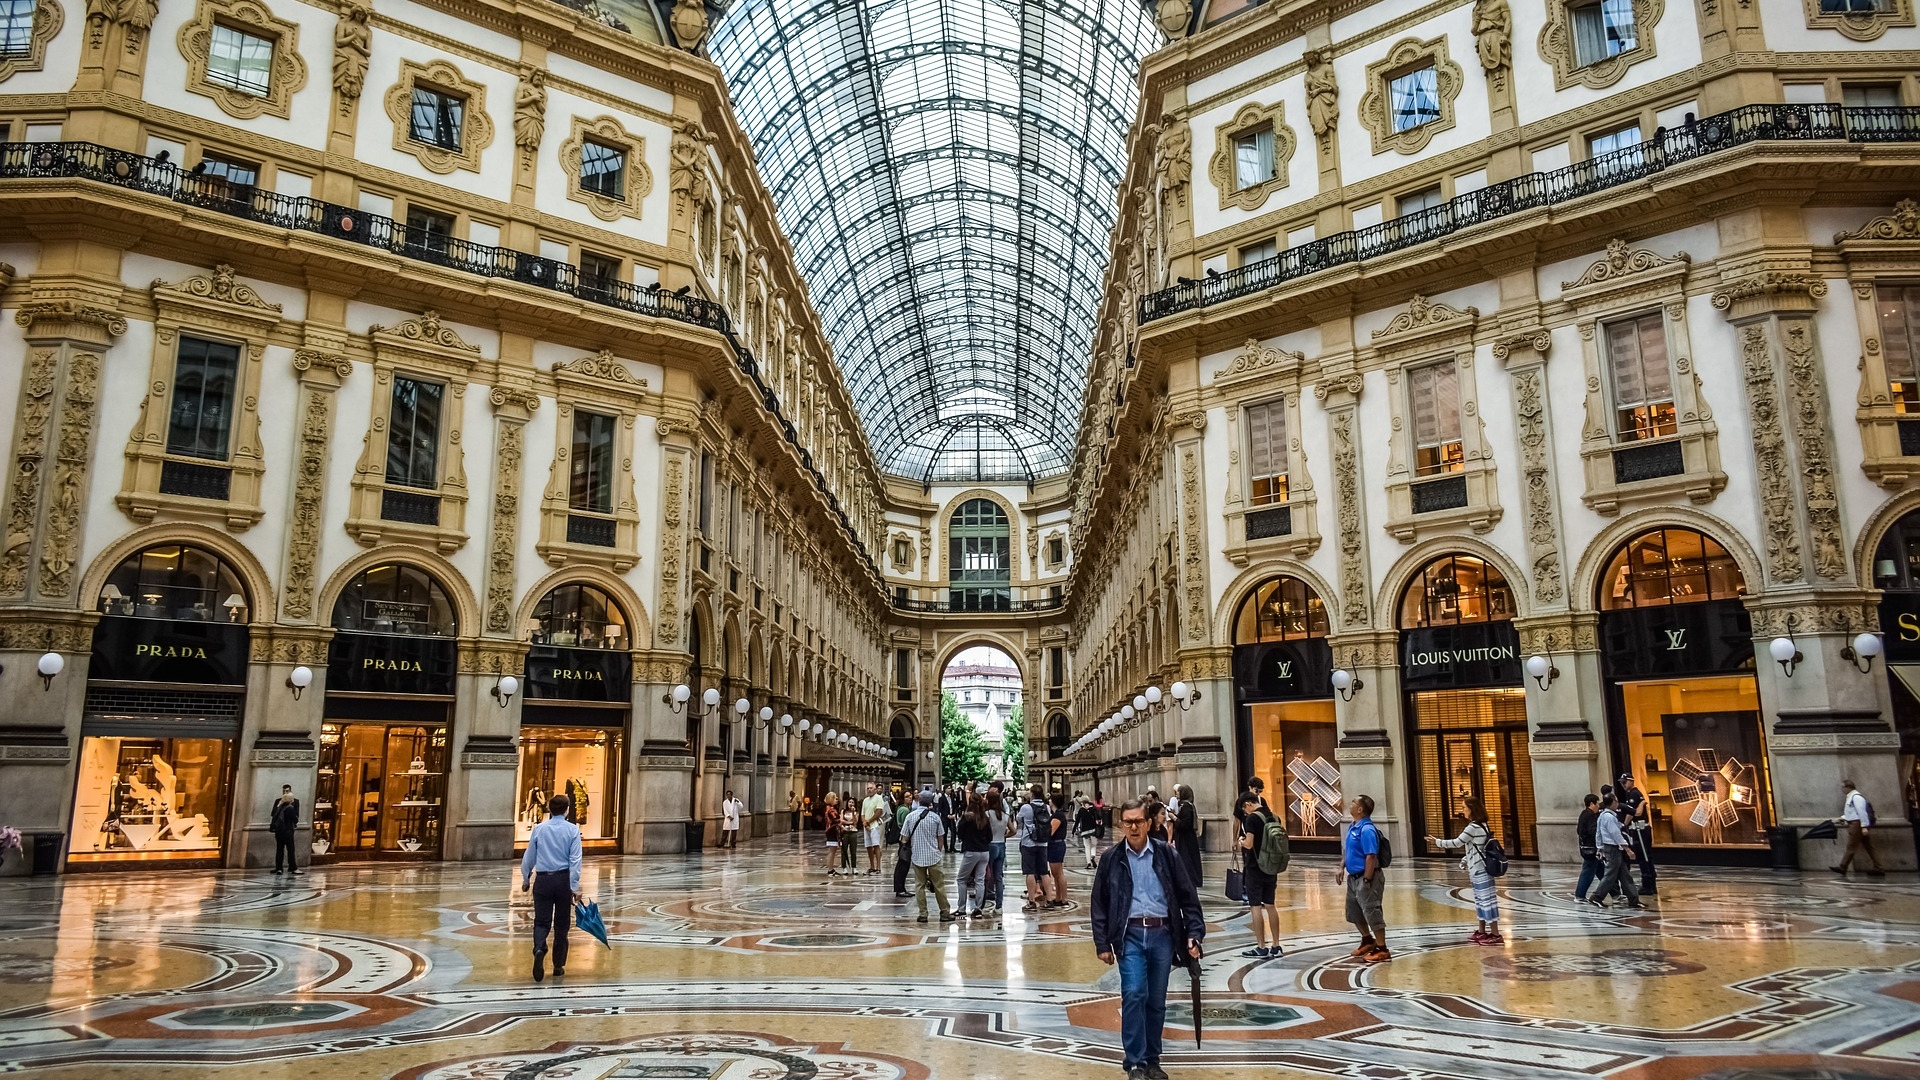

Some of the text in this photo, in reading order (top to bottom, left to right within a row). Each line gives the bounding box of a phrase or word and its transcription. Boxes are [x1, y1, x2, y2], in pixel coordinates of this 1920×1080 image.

[1898, 612, 1920, 641] S
[1664, 628, 1687, 650] LV
[136, 644, 207, 659] PRADA
[1411, 645, 1514, 666] LOUIS VUITTON
[363, 658, 422, 672] PRADA
[553, 668, 603, 681] PRADA
[1277, 660, 1293, 679] LV
